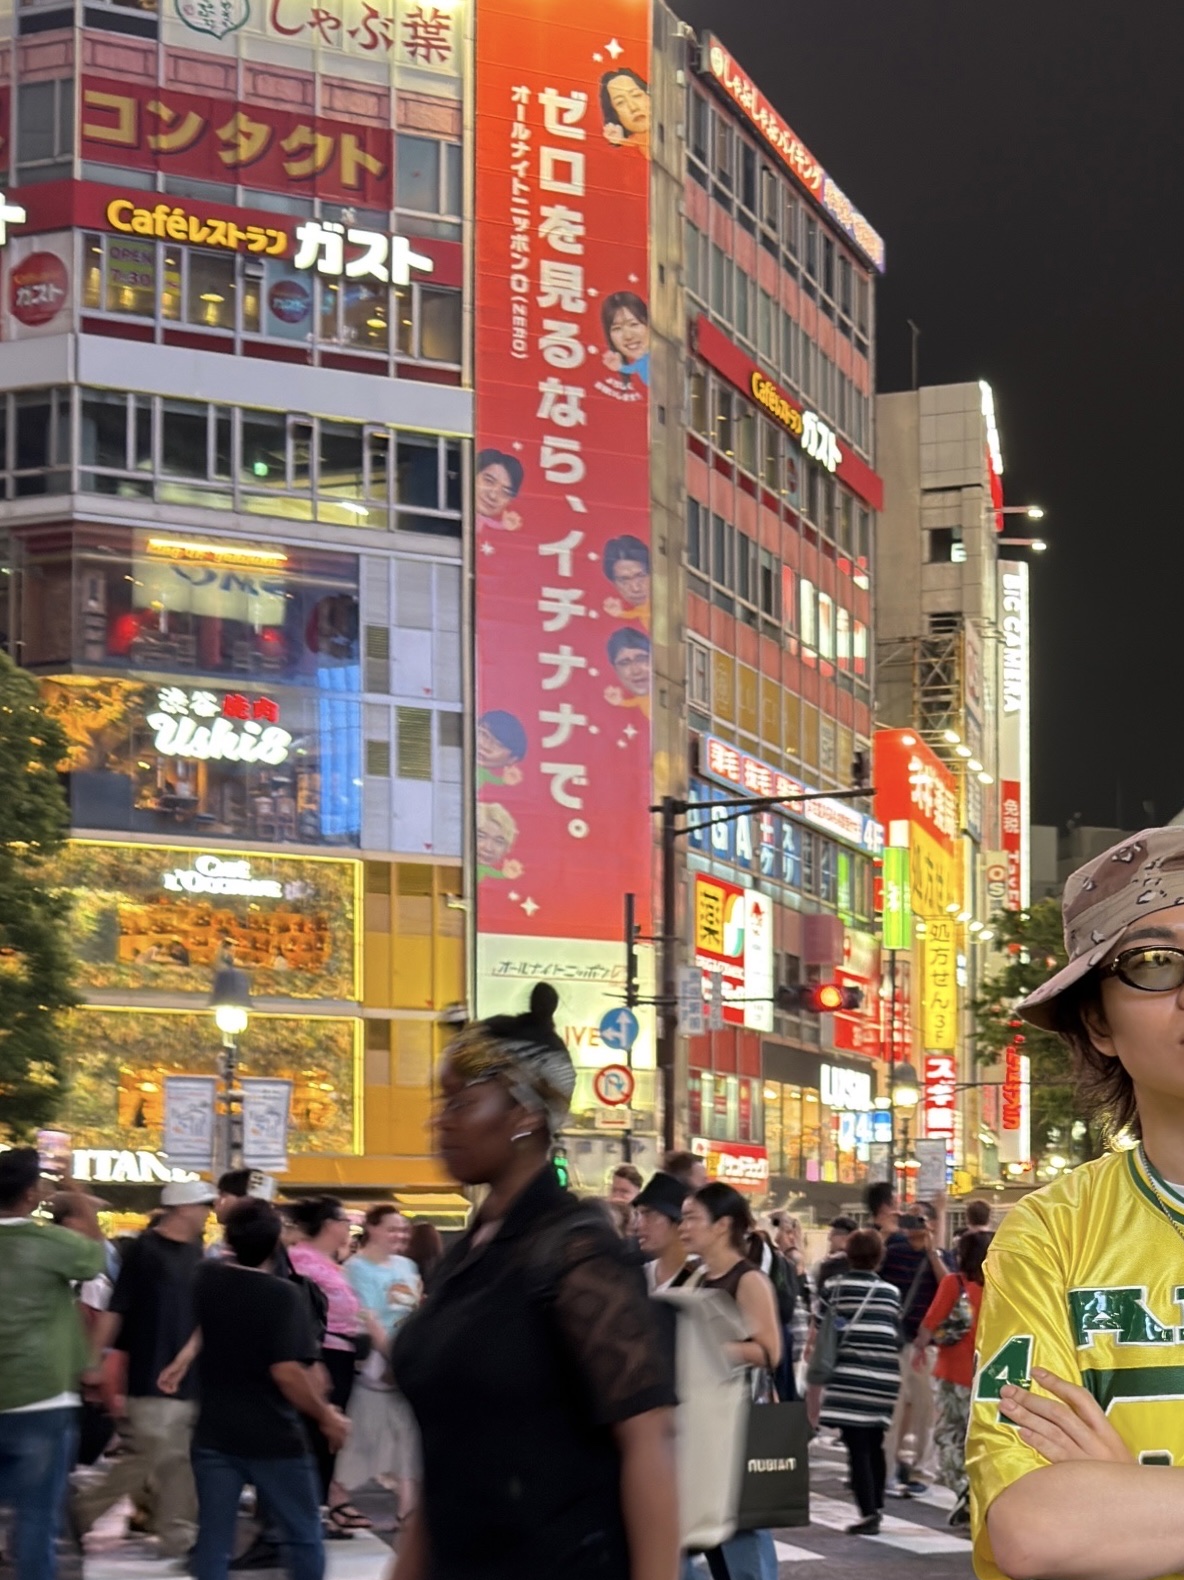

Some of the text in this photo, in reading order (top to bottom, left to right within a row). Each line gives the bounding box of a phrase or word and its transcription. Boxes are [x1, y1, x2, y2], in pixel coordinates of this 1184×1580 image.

[268, 0, 452, 63] しゃぶ葉
[83, 89, 387, 190] コンタクト
[107, 199, 434, 286] Caféレストラン ガスト
[536, 86, 590, 840] ゼロを見るなら、イチナナで。
[801, 410, 843, 473] ガスト
[146, 712, 292, 766] Ushi8
